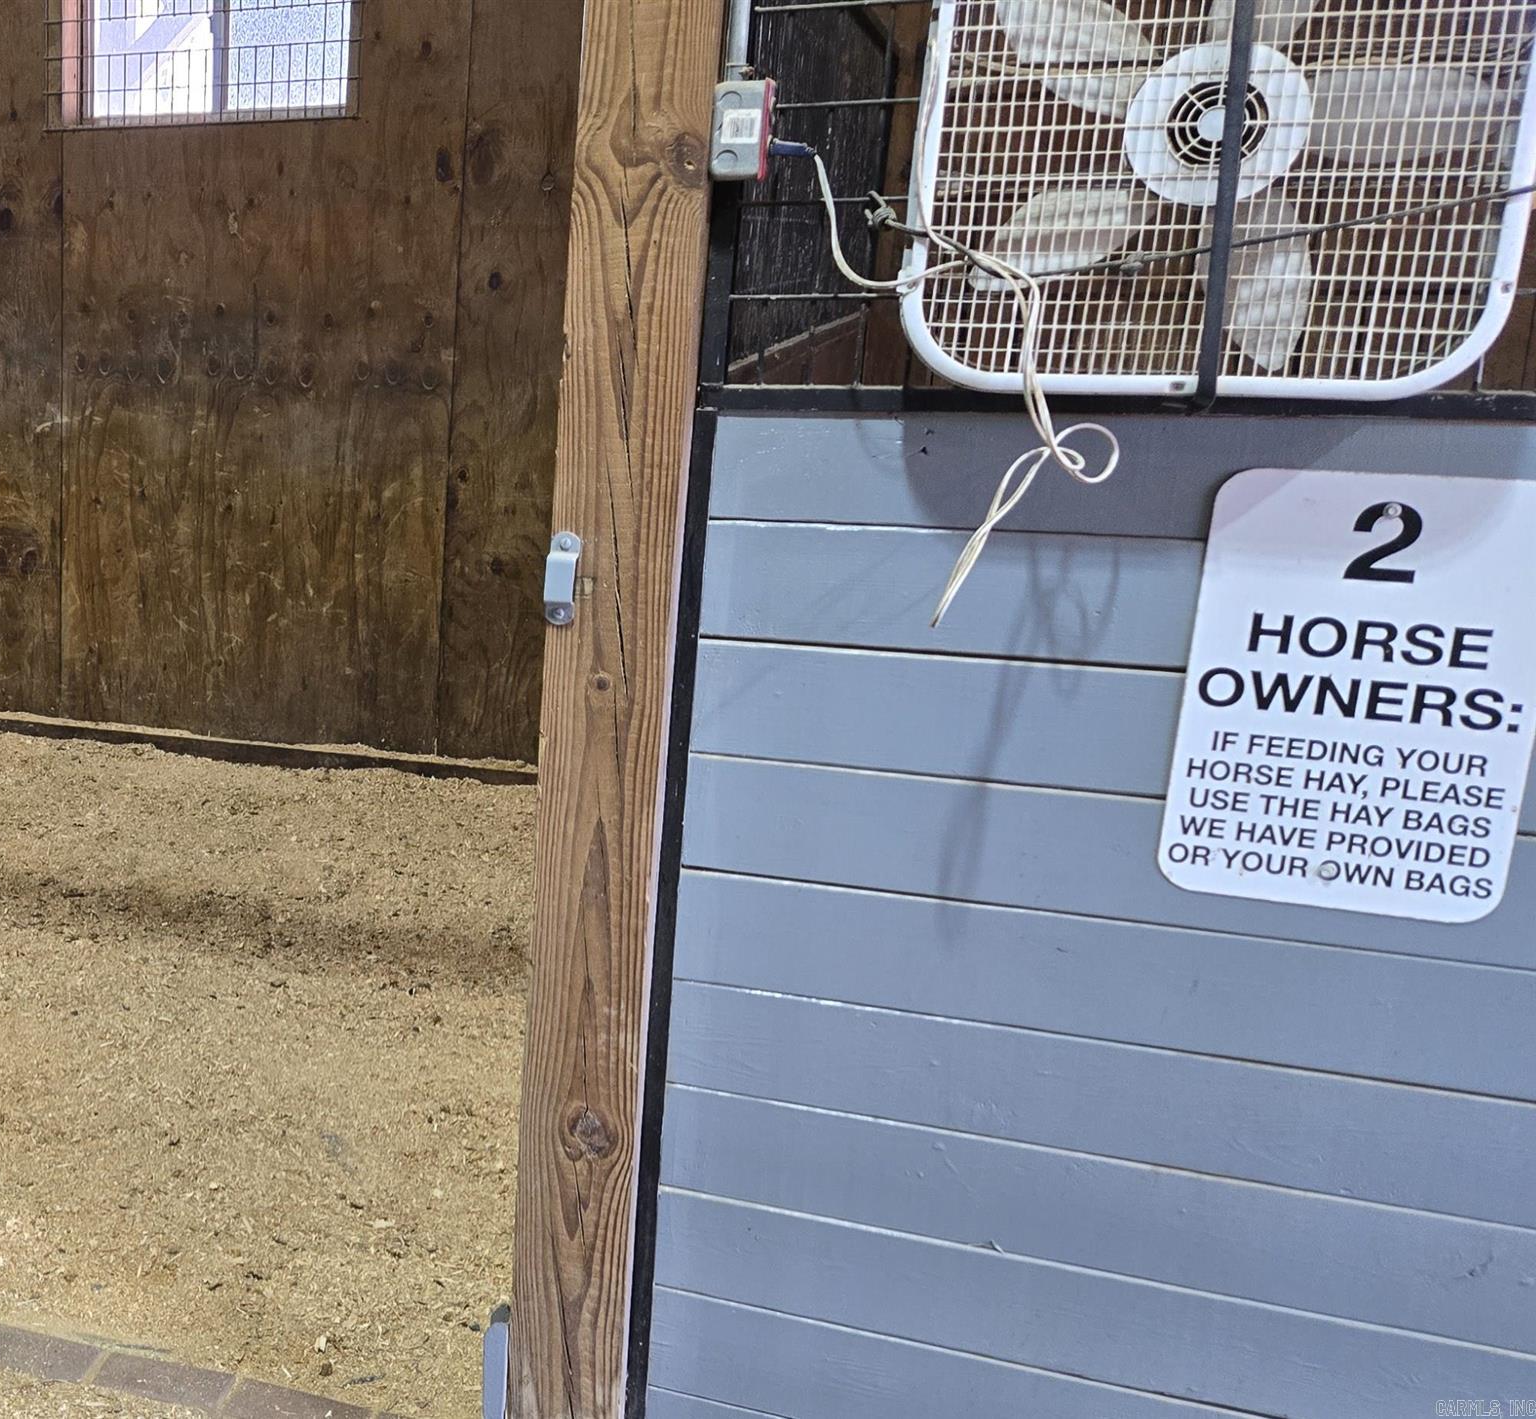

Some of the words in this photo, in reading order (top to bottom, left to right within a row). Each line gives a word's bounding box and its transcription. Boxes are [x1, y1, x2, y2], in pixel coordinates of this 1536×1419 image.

[1343, 501, 1423, 583] 2
[1247, 613, 1493, 670] HORSE
[1198, 667, 1523, 733] OWNERS:
[1211, 731, 1239, 752] IF
[1248, 734, 1384, 767] FEEDING
[1397, 748, 1487, 777] YOUR
[1186, 759, 1292, 788] HORSE
[1303, 770, 1368, 799] HAY,
[1380, 777, 1505, 810] PLEASE
[1189, 788, 1249, 812] USE
[1260, 795, 1320, 819] THE
[1330, 801, 1394, 827] HAY
[1402, 809, 1492, 837] BAGS
[1180, 815, 1225, 839] WE
[1236, 822, 1318, 849] HAVE
[1326, 832, 1490, 868] PROVIDED
[1168, 842, 1211, 865] OR
[1222, 848, 1309, 878] YOUR
[1318, 860, 1394, 888] OWN
[1405, 870, 1493, 899] BAGS
